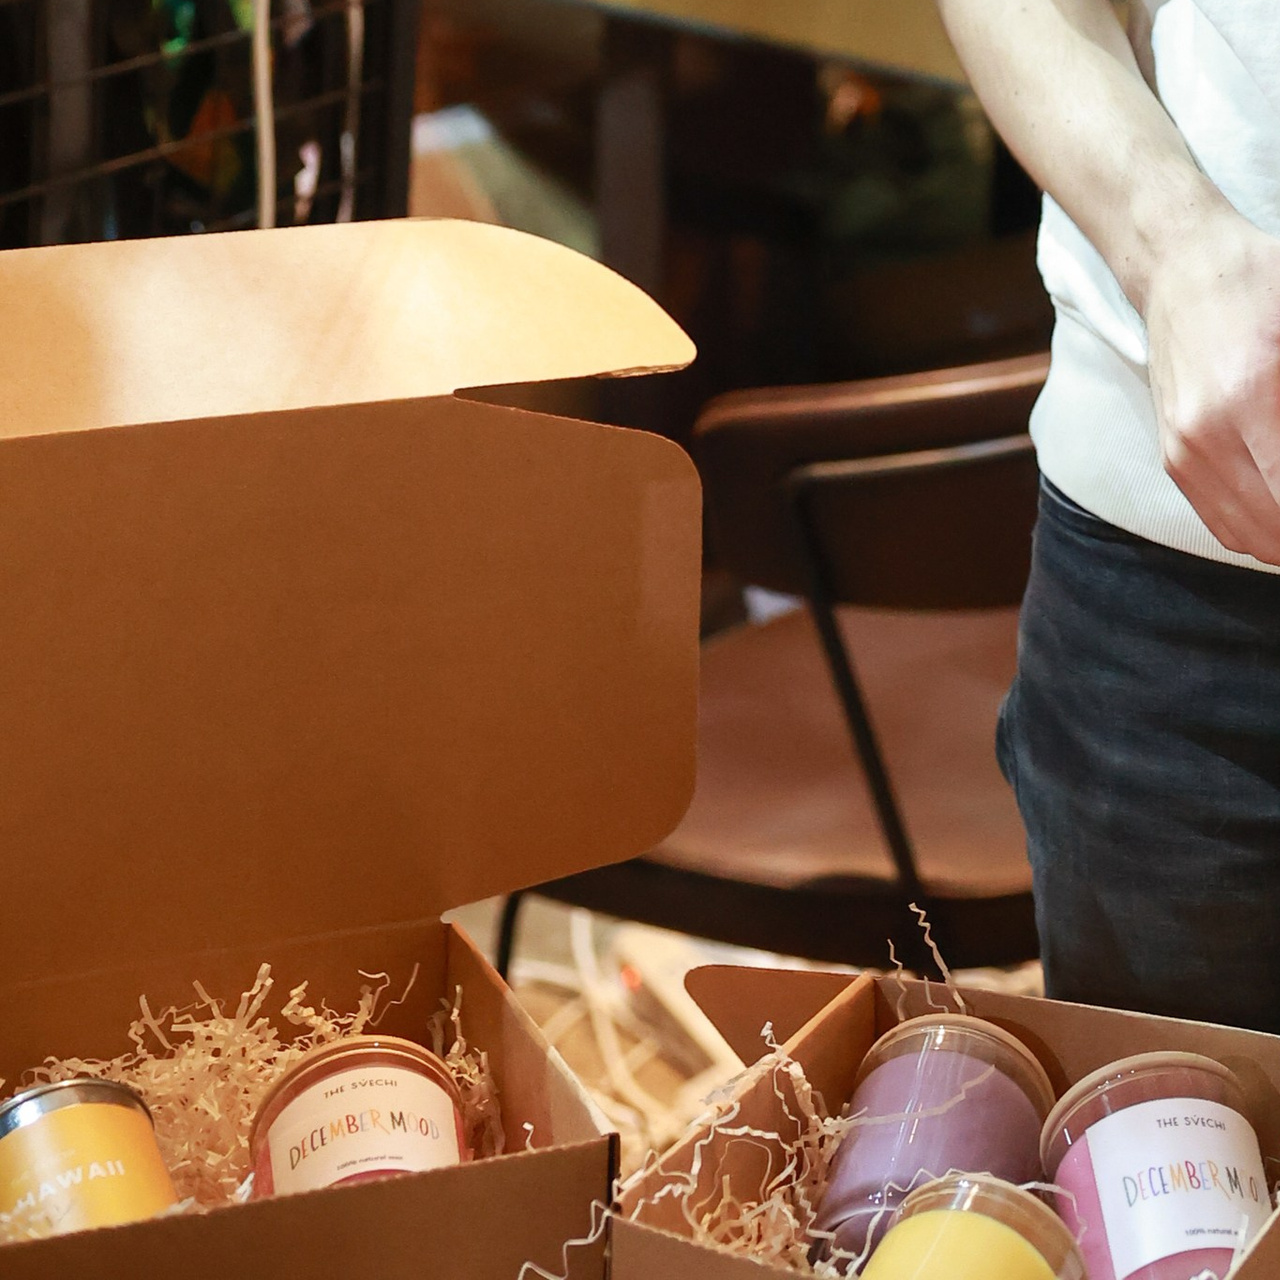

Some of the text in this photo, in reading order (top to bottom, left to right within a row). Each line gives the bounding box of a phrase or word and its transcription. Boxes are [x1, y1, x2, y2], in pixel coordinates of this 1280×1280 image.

[323, 1085, 345, 1099] THE
[289, 1109, 440, 1171] DECEMBER MOOD
[1156, 1117, 1179, 1128] THE
[12, 1160, 125, 1215] HAWAII
[1122, 1159, 1231, 1208] DECEMBER
